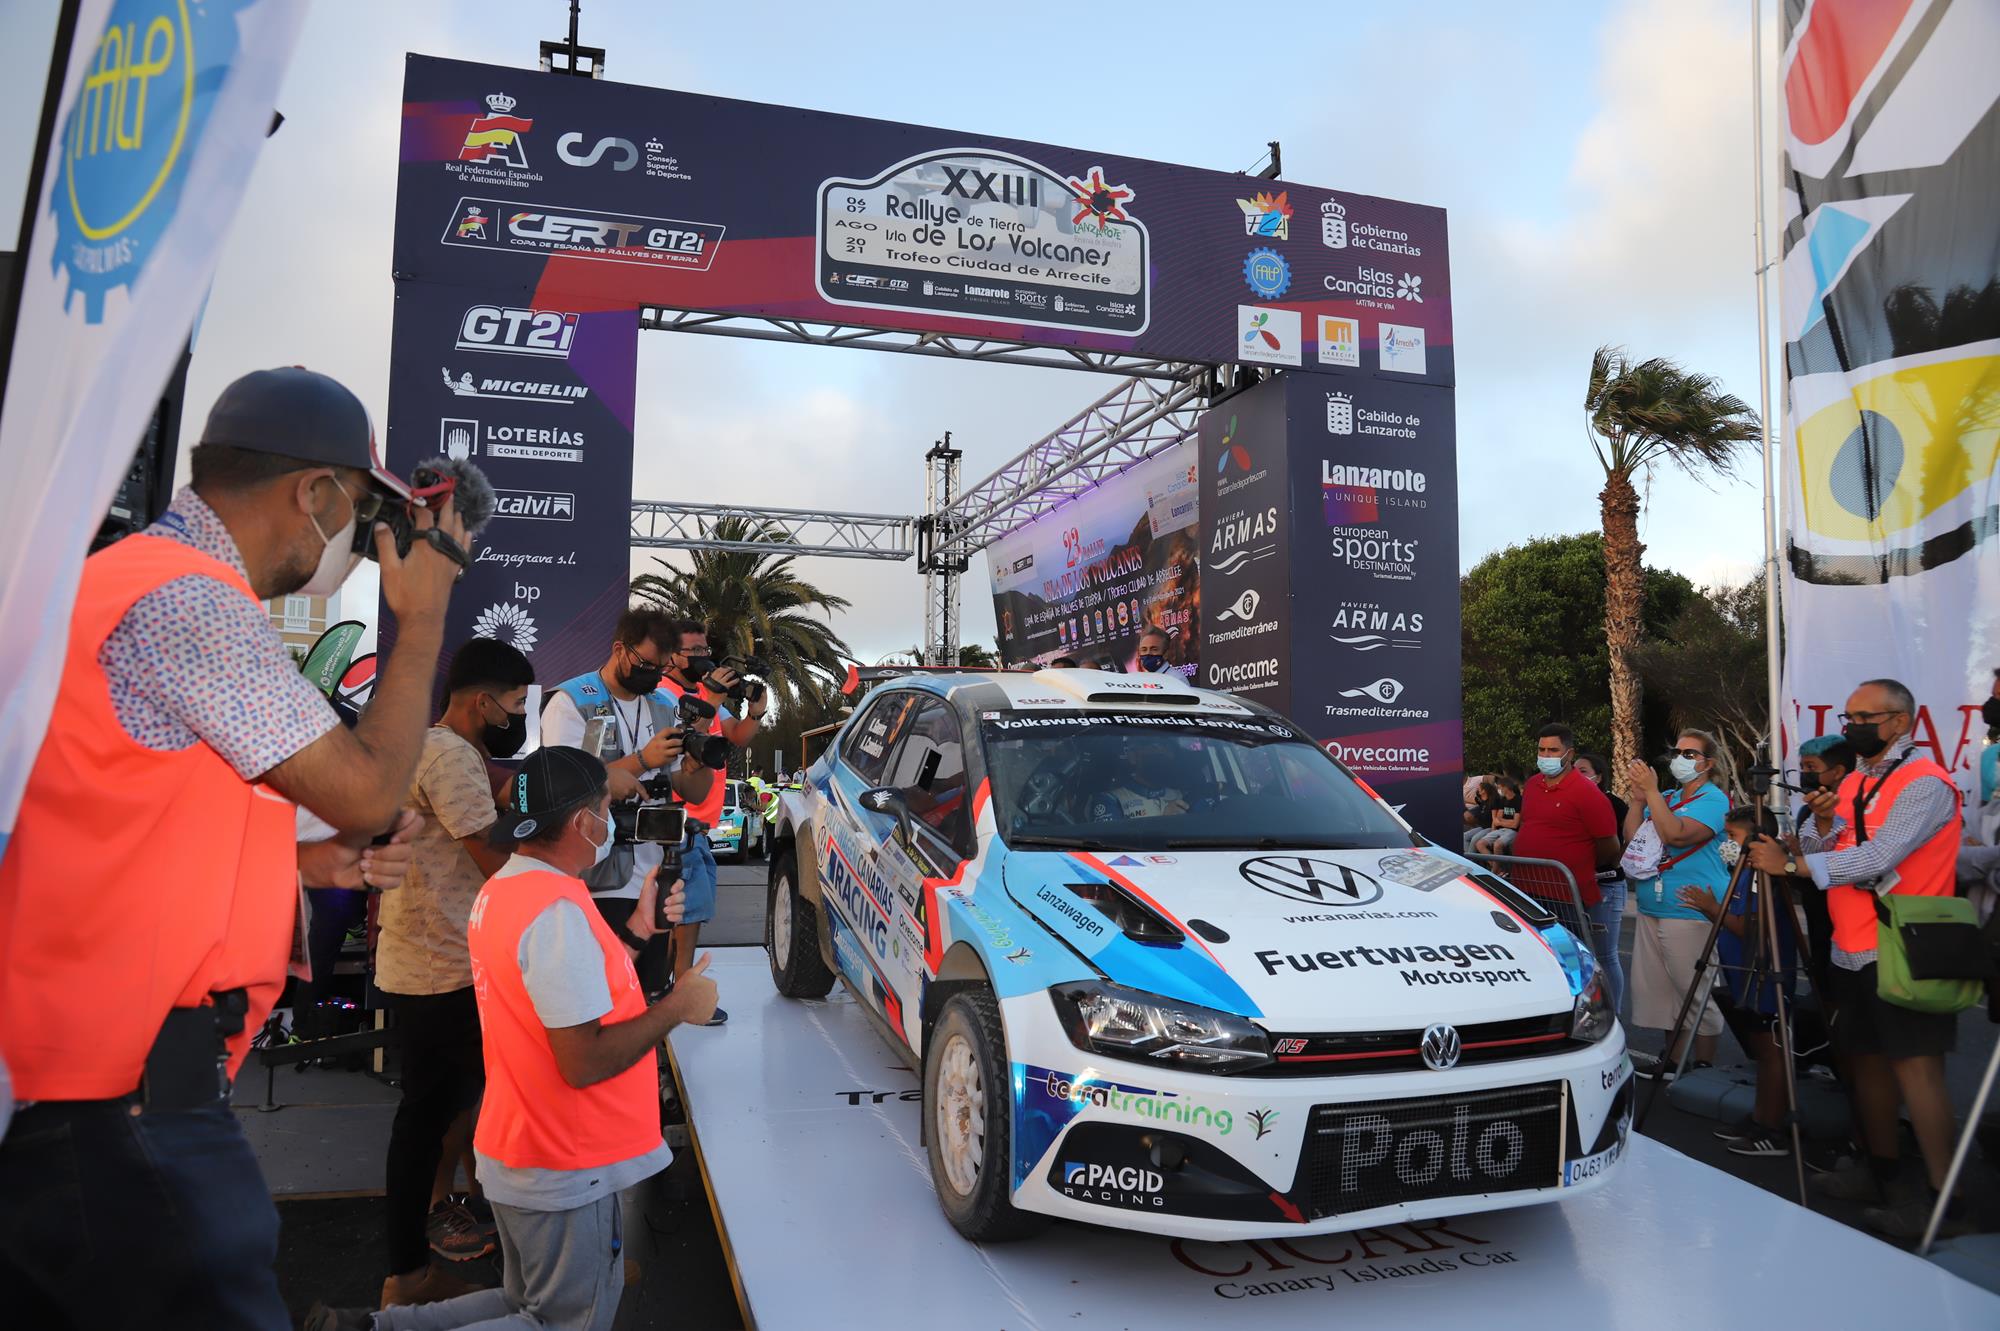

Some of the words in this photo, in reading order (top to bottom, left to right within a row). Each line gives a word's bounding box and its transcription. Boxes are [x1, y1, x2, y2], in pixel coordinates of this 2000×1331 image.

[646, 154, 678, 166] Consejo
[646, 161, 678, 172] Superior
[445, 162, 463, 173] Real
[464, 164, 506, 178] Federación
[508, 170, 544, 182] Española
[458, 172, 468, 181] de
[470, 173, 530, 188] Automovilismo
[646, 169, 656, 177] de
[658, 170, 692, 181] Deportes
[941, 165, 1038, 208] XXIII
[846, 196, 866, 206] 06
[846, 205, 866, 214] 07
[886, 194, 961, 227] Rallye
[967, 215, 984, 228] de
[989, 217, 1026, 233] Tierra
[508, 212, 644, 248] CERT
[647, 227, 705, 251] GT2i
[835, 219, 878, 232] AGO
[1351, 222, 1408, 242] Gobierno
[510, 238, 538, 248] COPA
[540, 241, 552, 249] DE
[554, 242, 592, 253] ESPAÑA
[594, 246, 606, 254] DE
[608, 248, 650, 258] RALLYES
[665, 254, 698, 264] TIERRA
[846, 236, 866, 246] 20
[846, 245, 864, 254] 21
[886, 229, 907, 243] Isla
[912, 224, 946, 247] de
[958, 228, 996, 252] Los
[1008, 234, 1112, 266] Volcanes
[1352, 237, 1367, 248] de
[1368, 239, 1422, 257] Canarias
[886, 248, 942, 265] Trofeo
[947, 254, 1012, 274] Ciudad
[1018, 263, 1040, 276] de
[1046, 268, 1112, 286] Arrecife
[1358, 266, 1394, 285] Islas
[846, 274, 888, 286] CERT
[1324, 276, 1395, 299] Canarias
[964, 284, 1010, 299] Lanzarote
[1014, 292, 1047, 304] sports
[463, 307, 576, 350] GT2i
[480, 378, 589, 399] MICHELIN
[1357, 408, 1402, 424] Cabildo
[1405, 414, 1420, 426] de
[487, 424, 584, 446] LOTERÍAS
[1357, 422, 1417, 439] Lanzarote
[497, 447, 518, 456] CON
[520, 448, 532, 456] EL
[532, 448, 573, 460] DEPORTE
[1322, 460, 1426, 492] Lanzarote
[1323, 492, 1330, 500] A
[1335, 492, 1380, 506] UNIQUE
[1385, 498, 1427, 509] ISLAND
[1217, 510, 1245, 526] NAVIERA
[1211, 507, 1278, 554] ARMAS
[1333, 526, 1389, 540] european
[475, 546, 553, 568] Lanzagrava
[556, 552, 577, 565] s.l.
[1062, 527, 1082, 568] 23
[1332, 537, 1416, 565] sports
[1044, 575, 1062, 604] ISLA
[1062, 576, 1075, 598] DE
[1076, 568, 1090, 592] LOS
[1090, 545, 1143, 586] VOLCANES
[1354, 560, 1410, 574] DESTINATION
[514, 582, 540, 604] bp
[1108, 583, 1128, 600] TROFEO
[1340, 601, 1380, 610] NAVIERA
[1332, 609, 1424, 633] ARMAS
[1208, 620, 1278, 645] Trasmediterránea
[1209, 657, 1279, 686] Orvecame
[581, 686, 598, 694] FIA
[1325, 705, 1430, 719] Trasmediterránea
[995, 716, 1112, 732] Volkswagen
[1115, 714, 1194, 727] Financial
[1198, 718, 1266, 734] Services
[1326, 741, 1430, 762] Orvecame
[518, 773, 528, 814] sparco
[857, 854, 894, 916] CANARIAS
[834, 859, 887, 959] RACING
[1036, 884, 1104, 937] Lanzawagen
[1282, 908, 1440, 926] vwcanarias.com
[1254, 938, 1516, 978] Fuertwagen
[1400, 968, 1532, 988] Motorsport
[1046, 1070, 1234, 1135] terratraining
[1342, 1104, 1523, 1193] Polo
[1573, 1156, 1601, 1181] 0463
[1090, 1166, 1164, 1194] PAGID
[1064, 1186, 1164, 1206] RACING
[1214, 1271, 1336, 1300] Canary
[1340, 1257, 1458, 1283] Islands
[1460, 1248, 1521, 1268] Car
